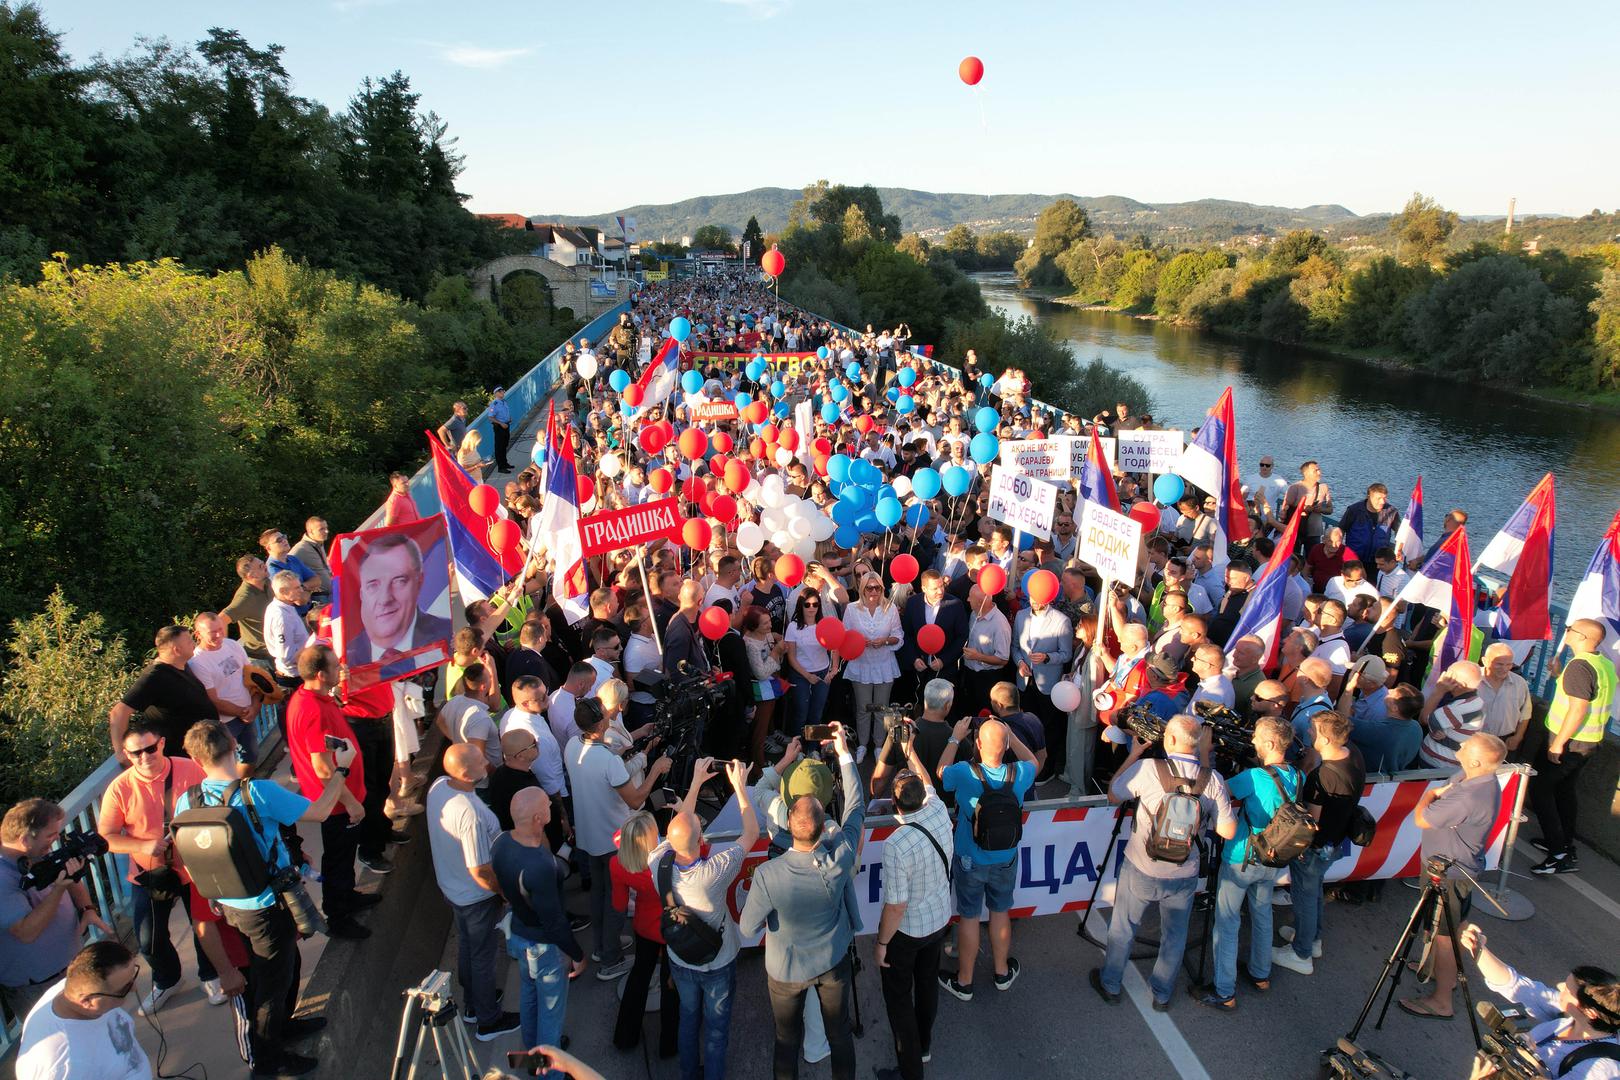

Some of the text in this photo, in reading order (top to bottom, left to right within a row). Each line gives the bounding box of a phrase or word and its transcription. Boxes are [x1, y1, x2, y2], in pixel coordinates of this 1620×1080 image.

[691, 404, 734, 417] ГРАДИШКА
[1011, 442, 1059, 453] АКО НЕ МОЖЕ
[1121, 446, 1134, 455] ЗА
[1015, 455, 1055, 466] У САРАЈЕВУ
[1025, 469, 1034, 477] НА
[1035, 467, 1067, 477] ГРАНИЦИ
[999, 474, 1046, 504] ДОБОЈ ЈЕ
[991, 495, 1049, 531] ГРАД ХЕРОЈ
[1092, 509, 1132, 537] ОВДЈЕ СЕ
[583, 506, 676, 547] ГРАДИШКА
[1088, 527, 1131, 561] ДОДИК
[1095, 553, 1117, 573] ПИТА
